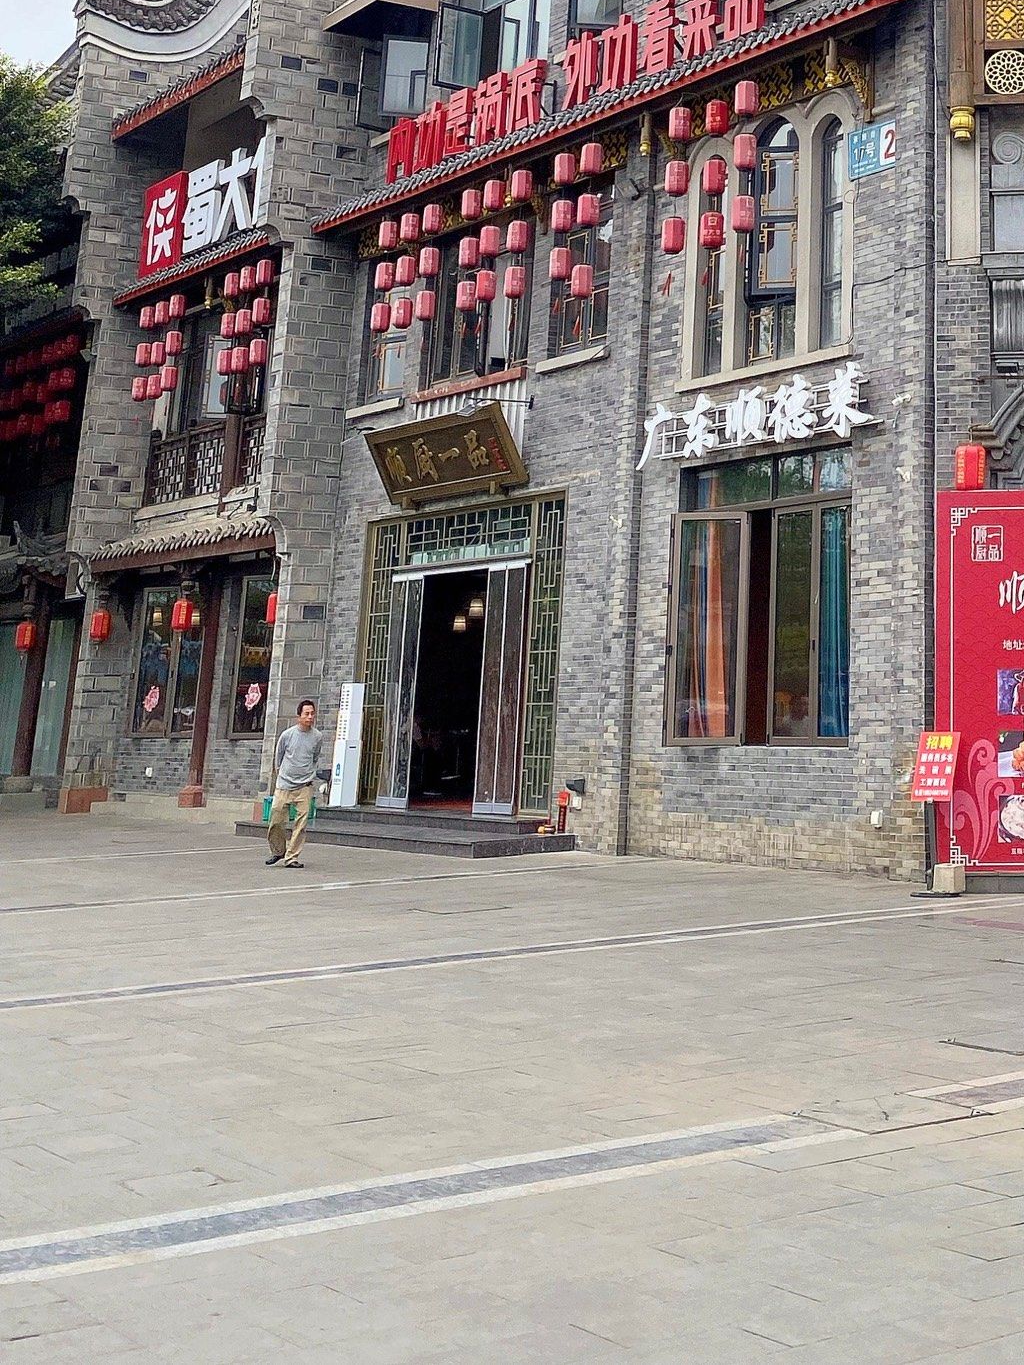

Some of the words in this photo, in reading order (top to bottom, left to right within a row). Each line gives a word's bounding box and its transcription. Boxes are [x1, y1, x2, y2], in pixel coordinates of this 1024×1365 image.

[385, 58, 547, 185] 内功是锅底
[636, 362, 874, 470] 广东顺德菜
[926, 735, 953, 751] 招聘
